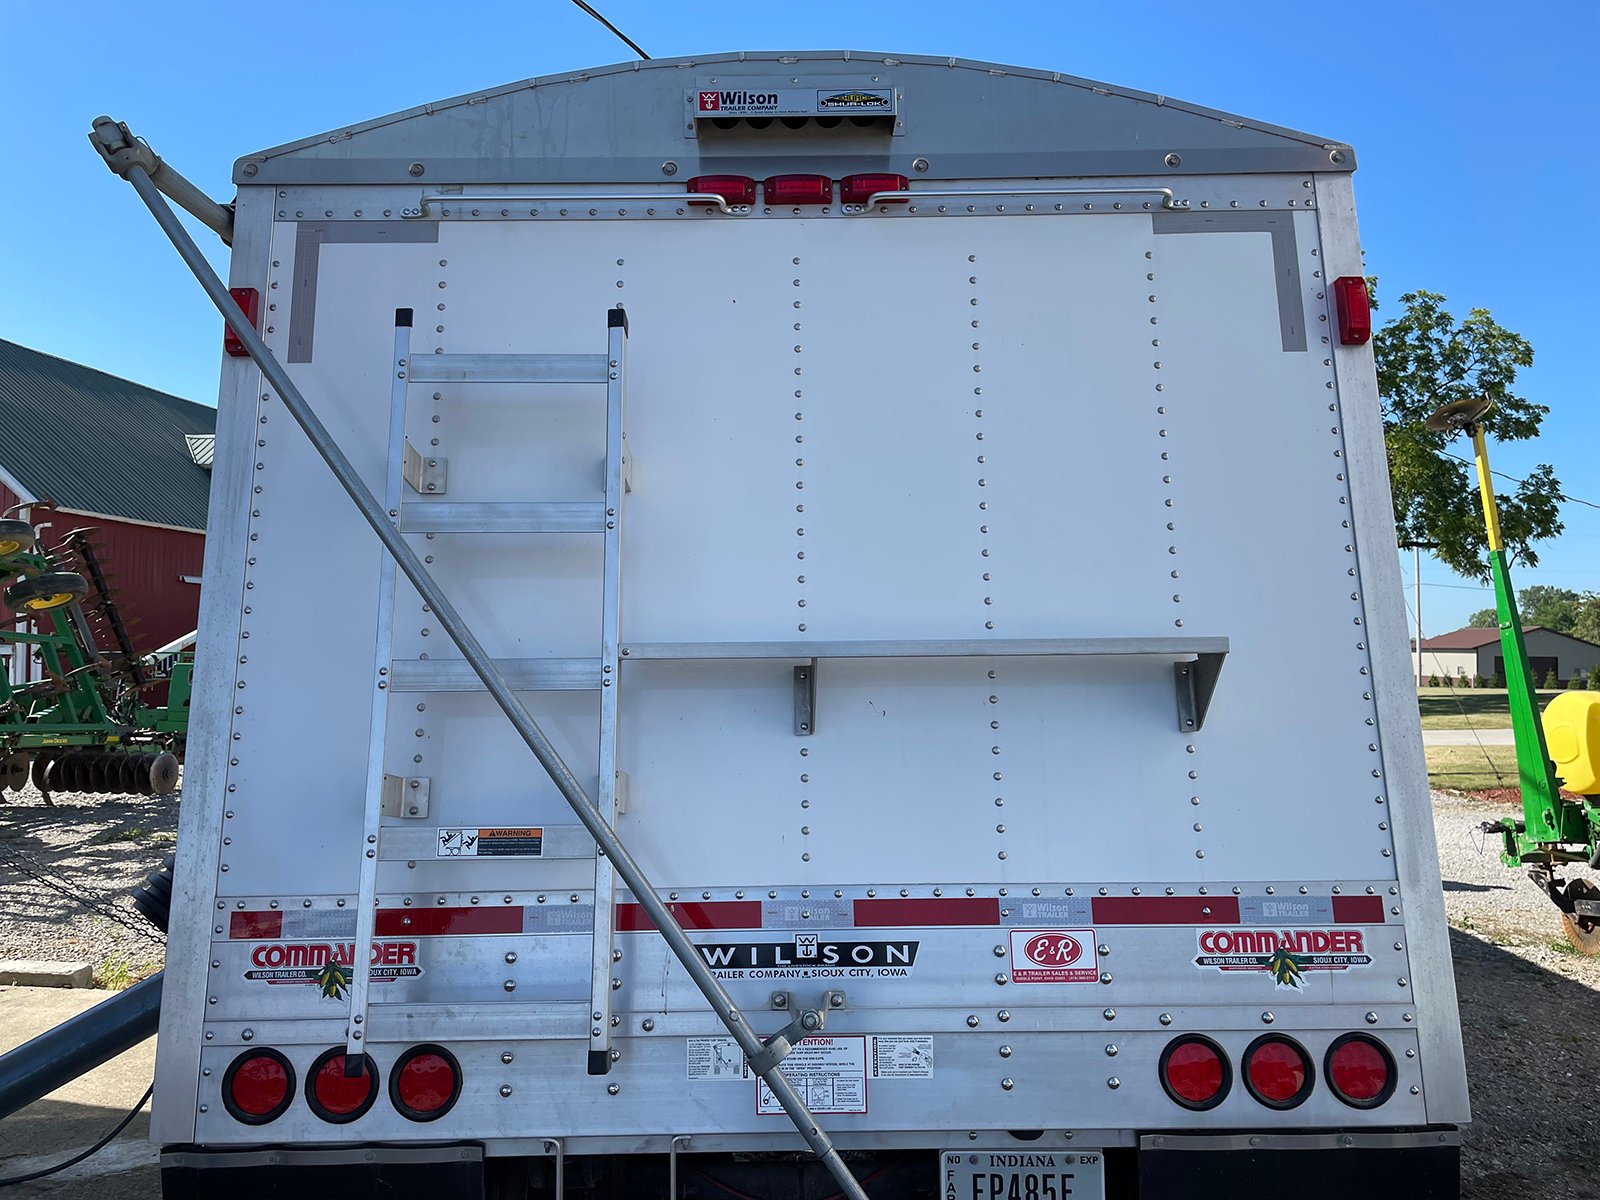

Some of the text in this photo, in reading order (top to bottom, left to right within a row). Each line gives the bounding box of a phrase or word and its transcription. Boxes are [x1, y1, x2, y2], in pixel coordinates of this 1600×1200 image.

[720, 91, 778, 105] Wilson
[495, 829, 532, 837] WARNING
[1200, 930, 1364, 954] COMMANDER
[701, 944, 910, 966] WILSON
[1203, 957, 1225, 965] WILSON
[1225, 957, 1248, 965] TRAILER
[1312, 957, 1332, 965] SIOUX
[252, 970, 274, 979] WILSON
[274, 970, 298, 978] TRAILER
[400, 967, 417, 975] IOWA
[749, 969, 801, 978] COMPANY
[811, 968, 907, 978] SIOUX CITY, IOWA
[947, 1155, 961, 1164] NO
[989, 1155, 1056, 1167] INDIANA
[1079, 1155, 1099, 1165] EXP
